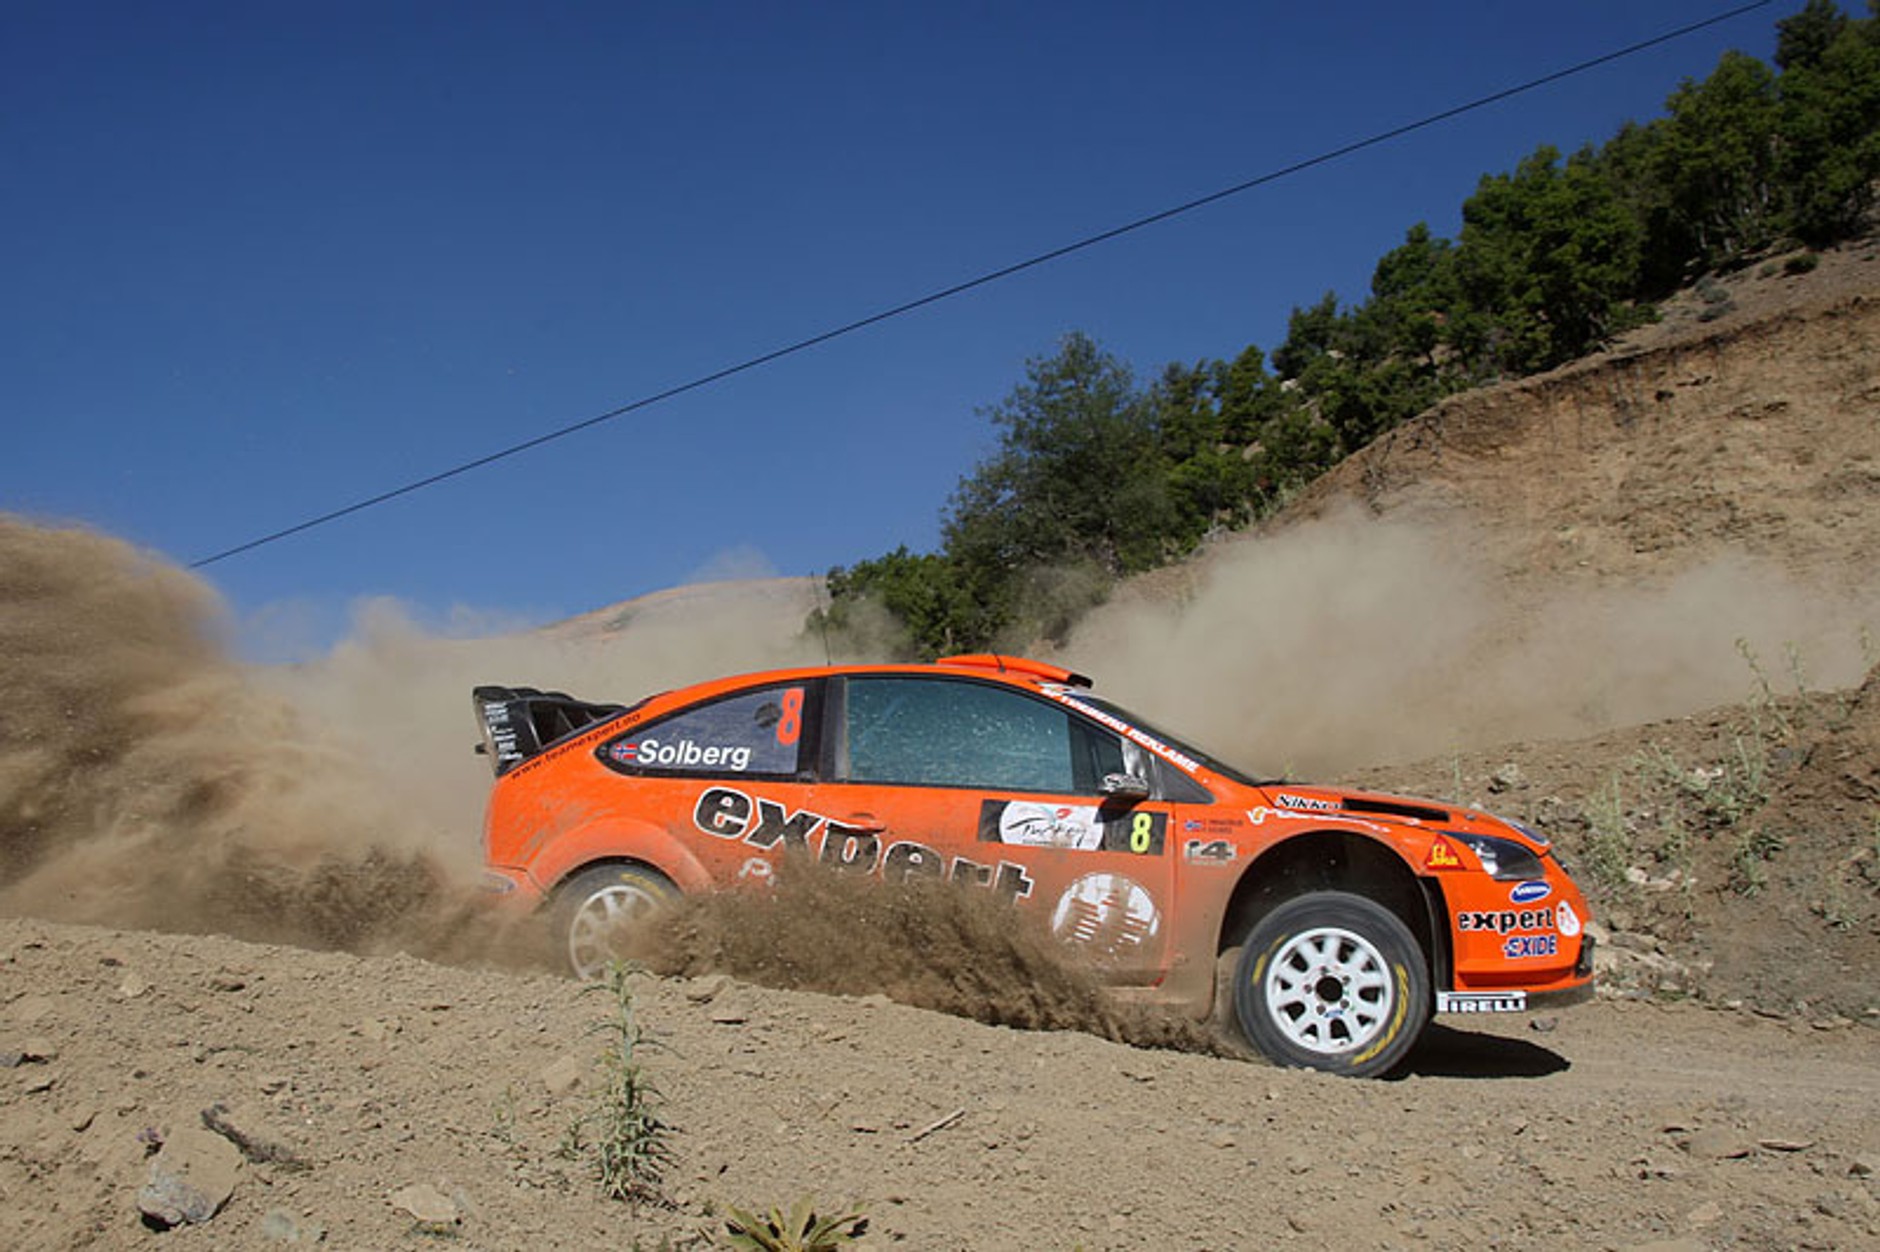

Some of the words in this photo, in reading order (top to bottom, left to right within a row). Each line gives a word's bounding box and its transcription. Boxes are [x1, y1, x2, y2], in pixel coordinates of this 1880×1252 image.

[776, 687, 804, 746] 8
[636, 739, 751, 772] Solberg
[1130, 812, 1152, 854] 8
[1457, 908, 1554, 935] expert
[1505, 935, 1557, 959] EXIDE
[1436, 990, 1526, 1012] PIRELLI
